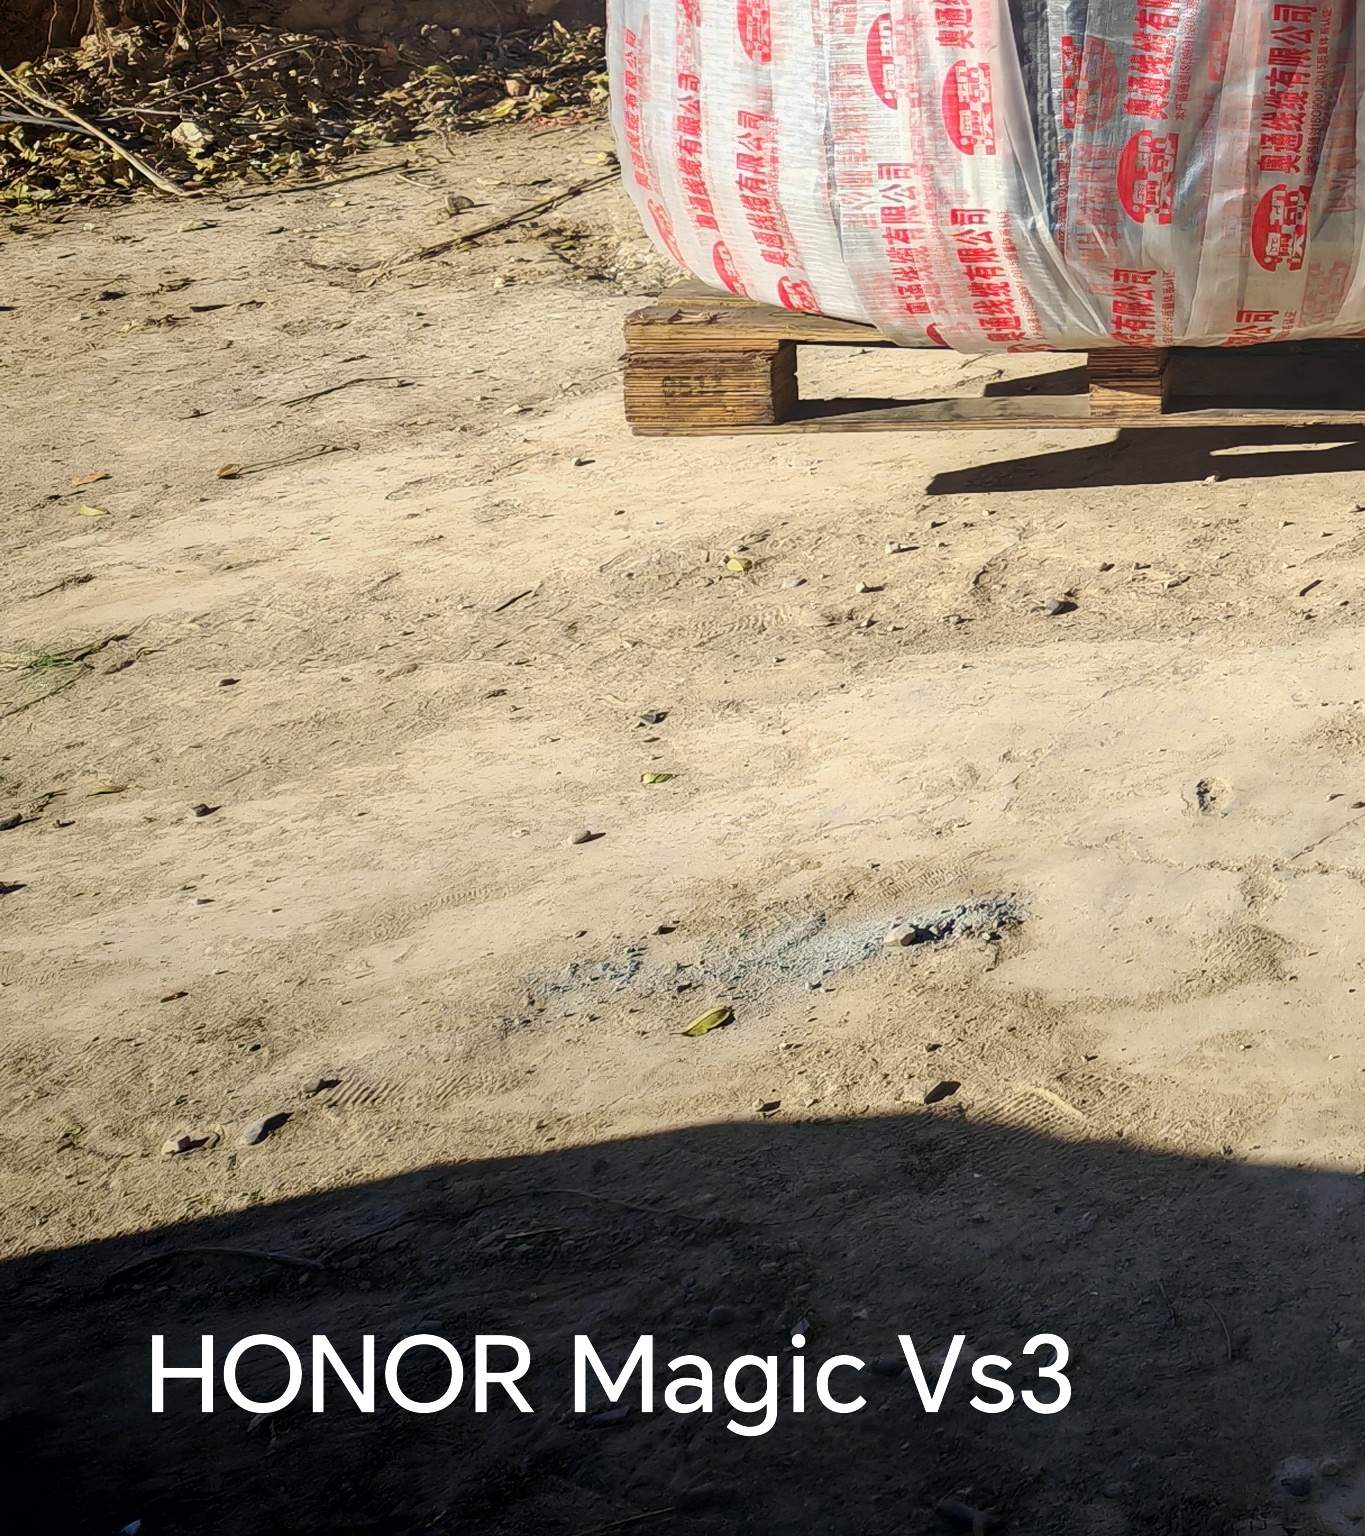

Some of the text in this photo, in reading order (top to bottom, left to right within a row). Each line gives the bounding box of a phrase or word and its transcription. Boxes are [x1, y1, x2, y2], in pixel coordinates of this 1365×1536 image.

[1256, 3, 1317, 173] 奥通线缆有限公司
[735, 110, 791, 269] 奥通线缆有限公司
[949, 207, 1026, 343] 奥通线缆有限公司
